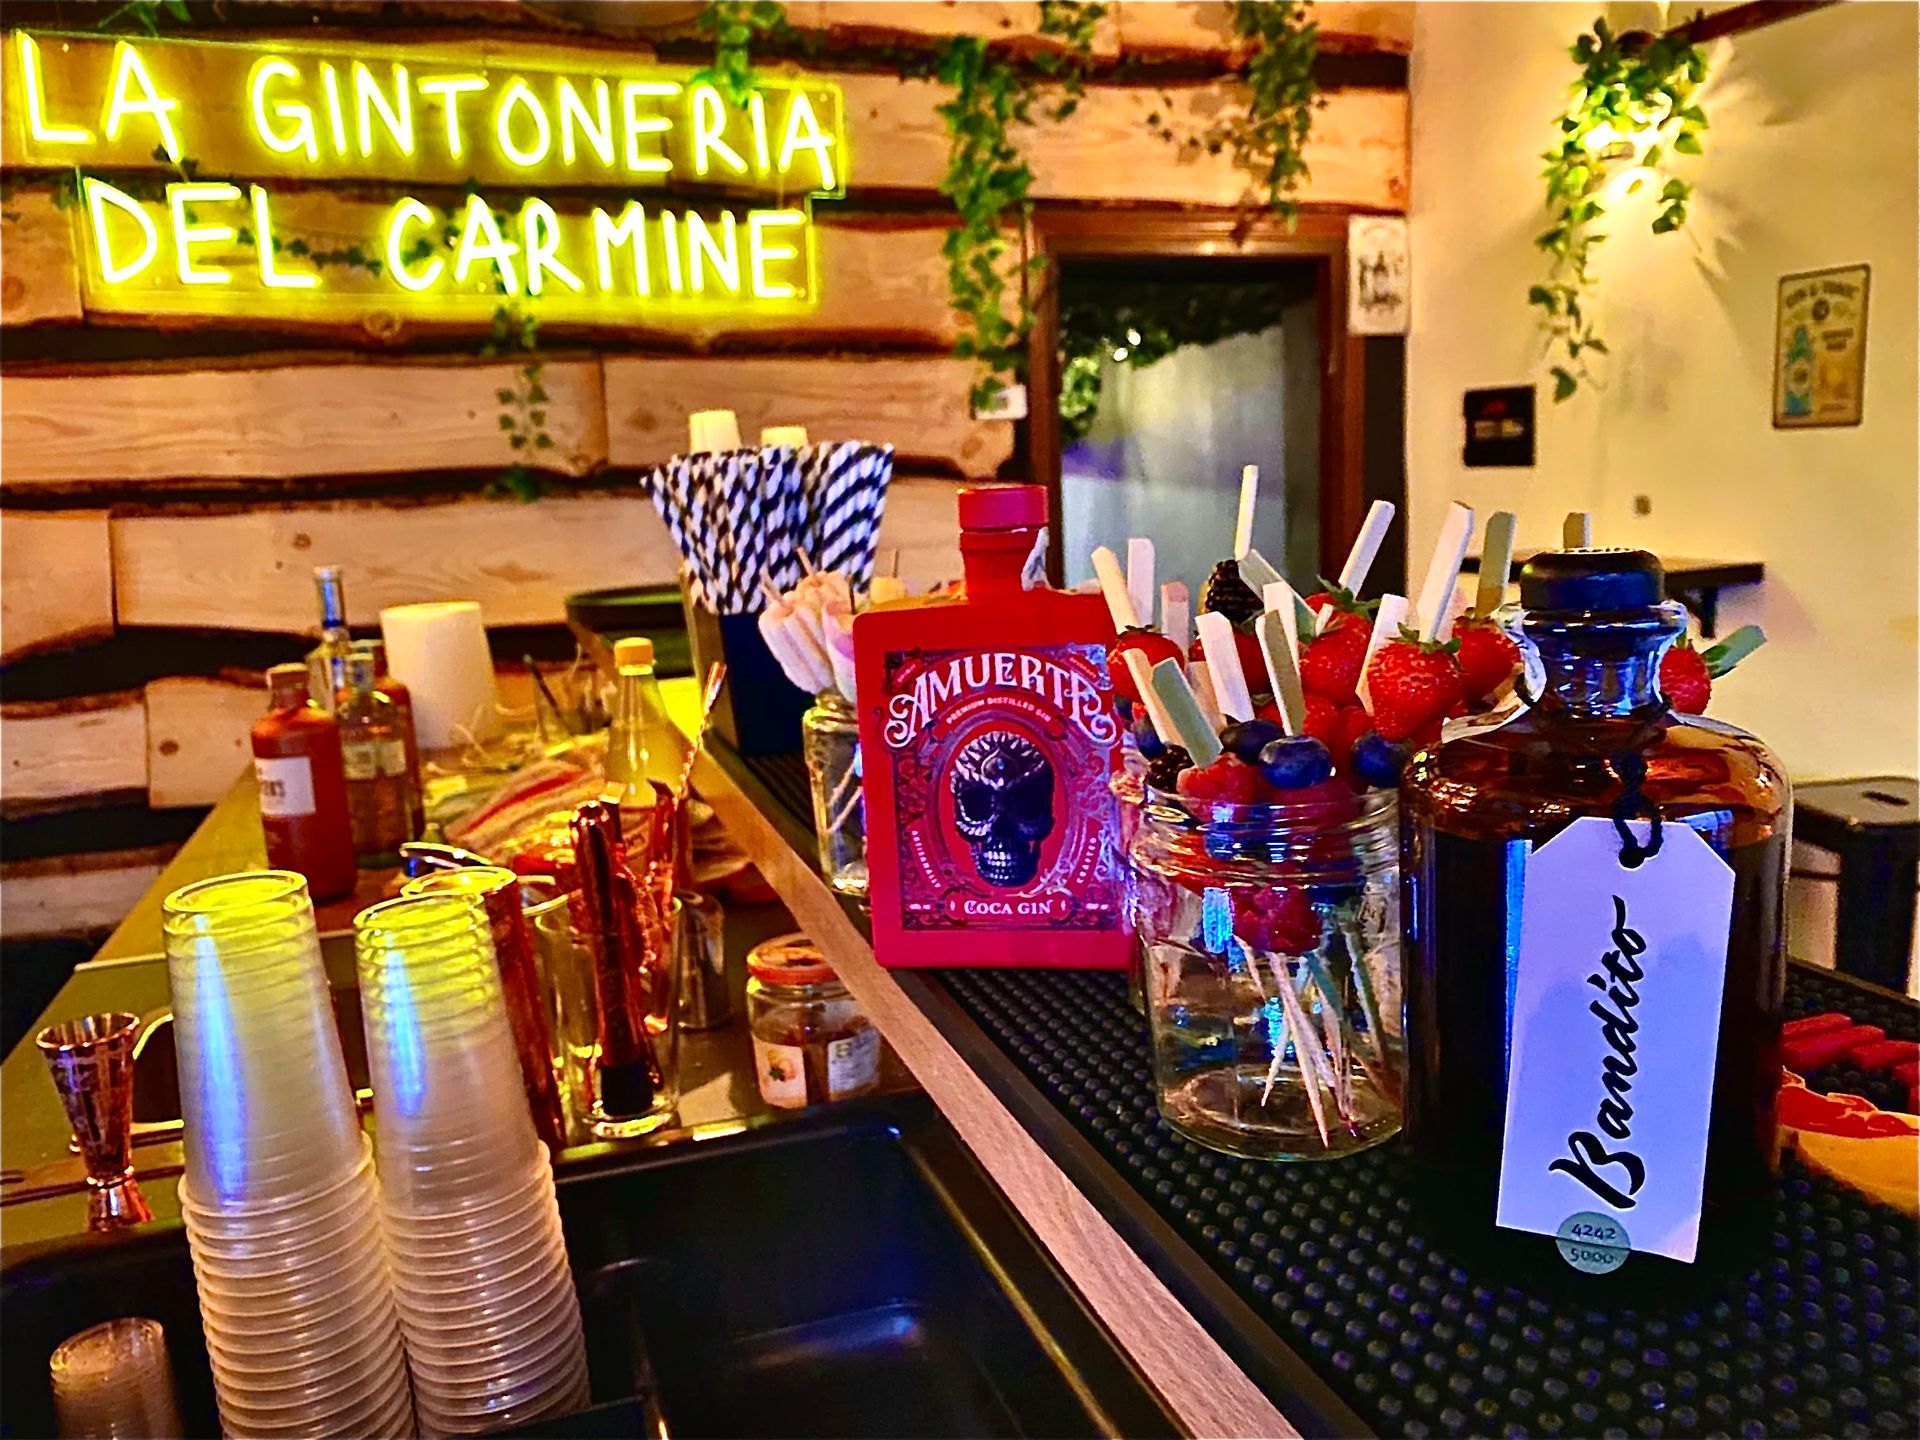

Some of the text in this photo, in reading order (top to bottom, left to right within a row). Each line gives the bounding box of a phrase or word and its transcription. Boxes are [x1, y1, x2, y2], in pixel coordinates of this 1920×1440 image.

[12, 28, 838, 192] LA GINTONERIA
[82, 174, 807, 299] DEL CARMINE
[883, 653, 1118, 748] AMUERTE
[945, 697, 1052, 725] PREMIUM DISTILLED GIN
[1076, 837, 1097, 884] CRAFTED
[964, 899, 1053, 915] COCA GIN
[1549, 894, 1648, 1210] Bandito
[1571, 1223, 1616, 1240] 4242
[1569, 1247, 1615, 1265] 5000
